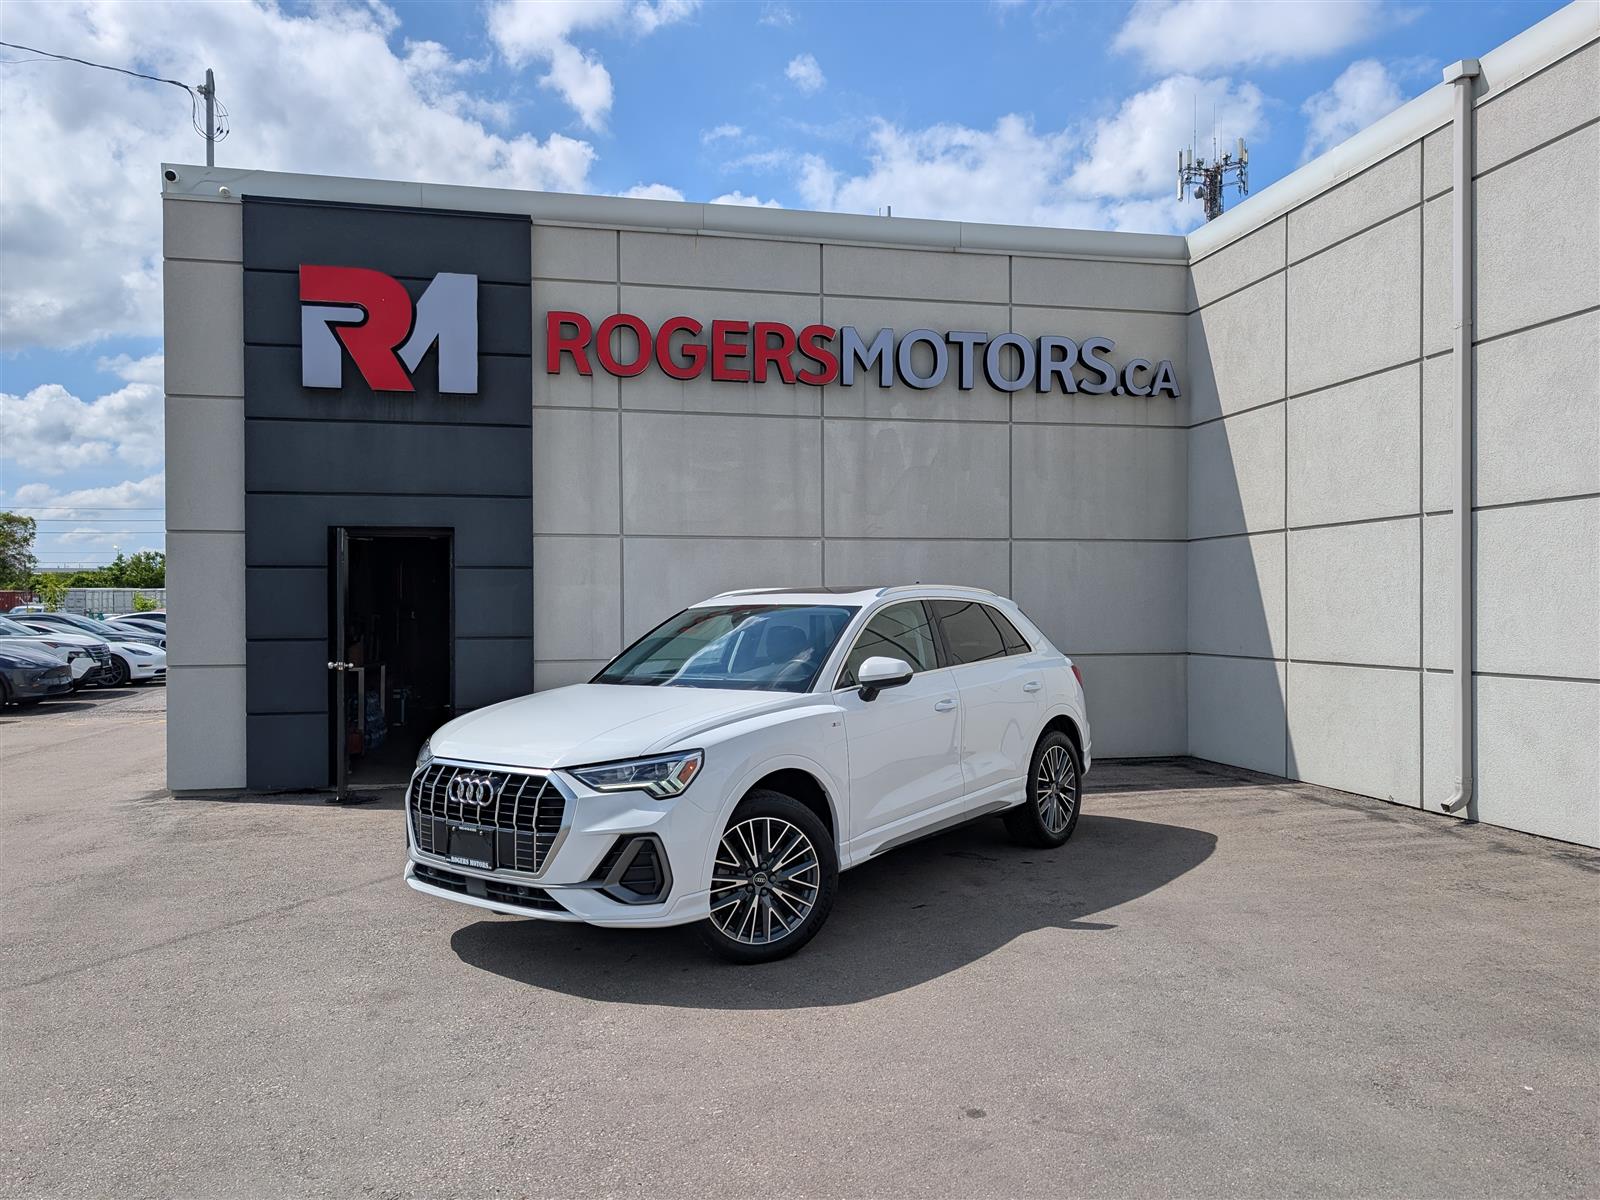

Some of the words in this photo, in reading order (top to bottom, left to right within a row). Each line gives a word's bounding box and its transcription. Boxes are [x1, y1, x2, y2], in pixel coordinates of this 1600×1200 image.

[298, 263, 479, 394] RM
[546, 310, 1181, 397] ROGERSMOTORS.CA
[450, 856, 469, 866] ROGERS
[469, 859, 489, 869] MOTORS
